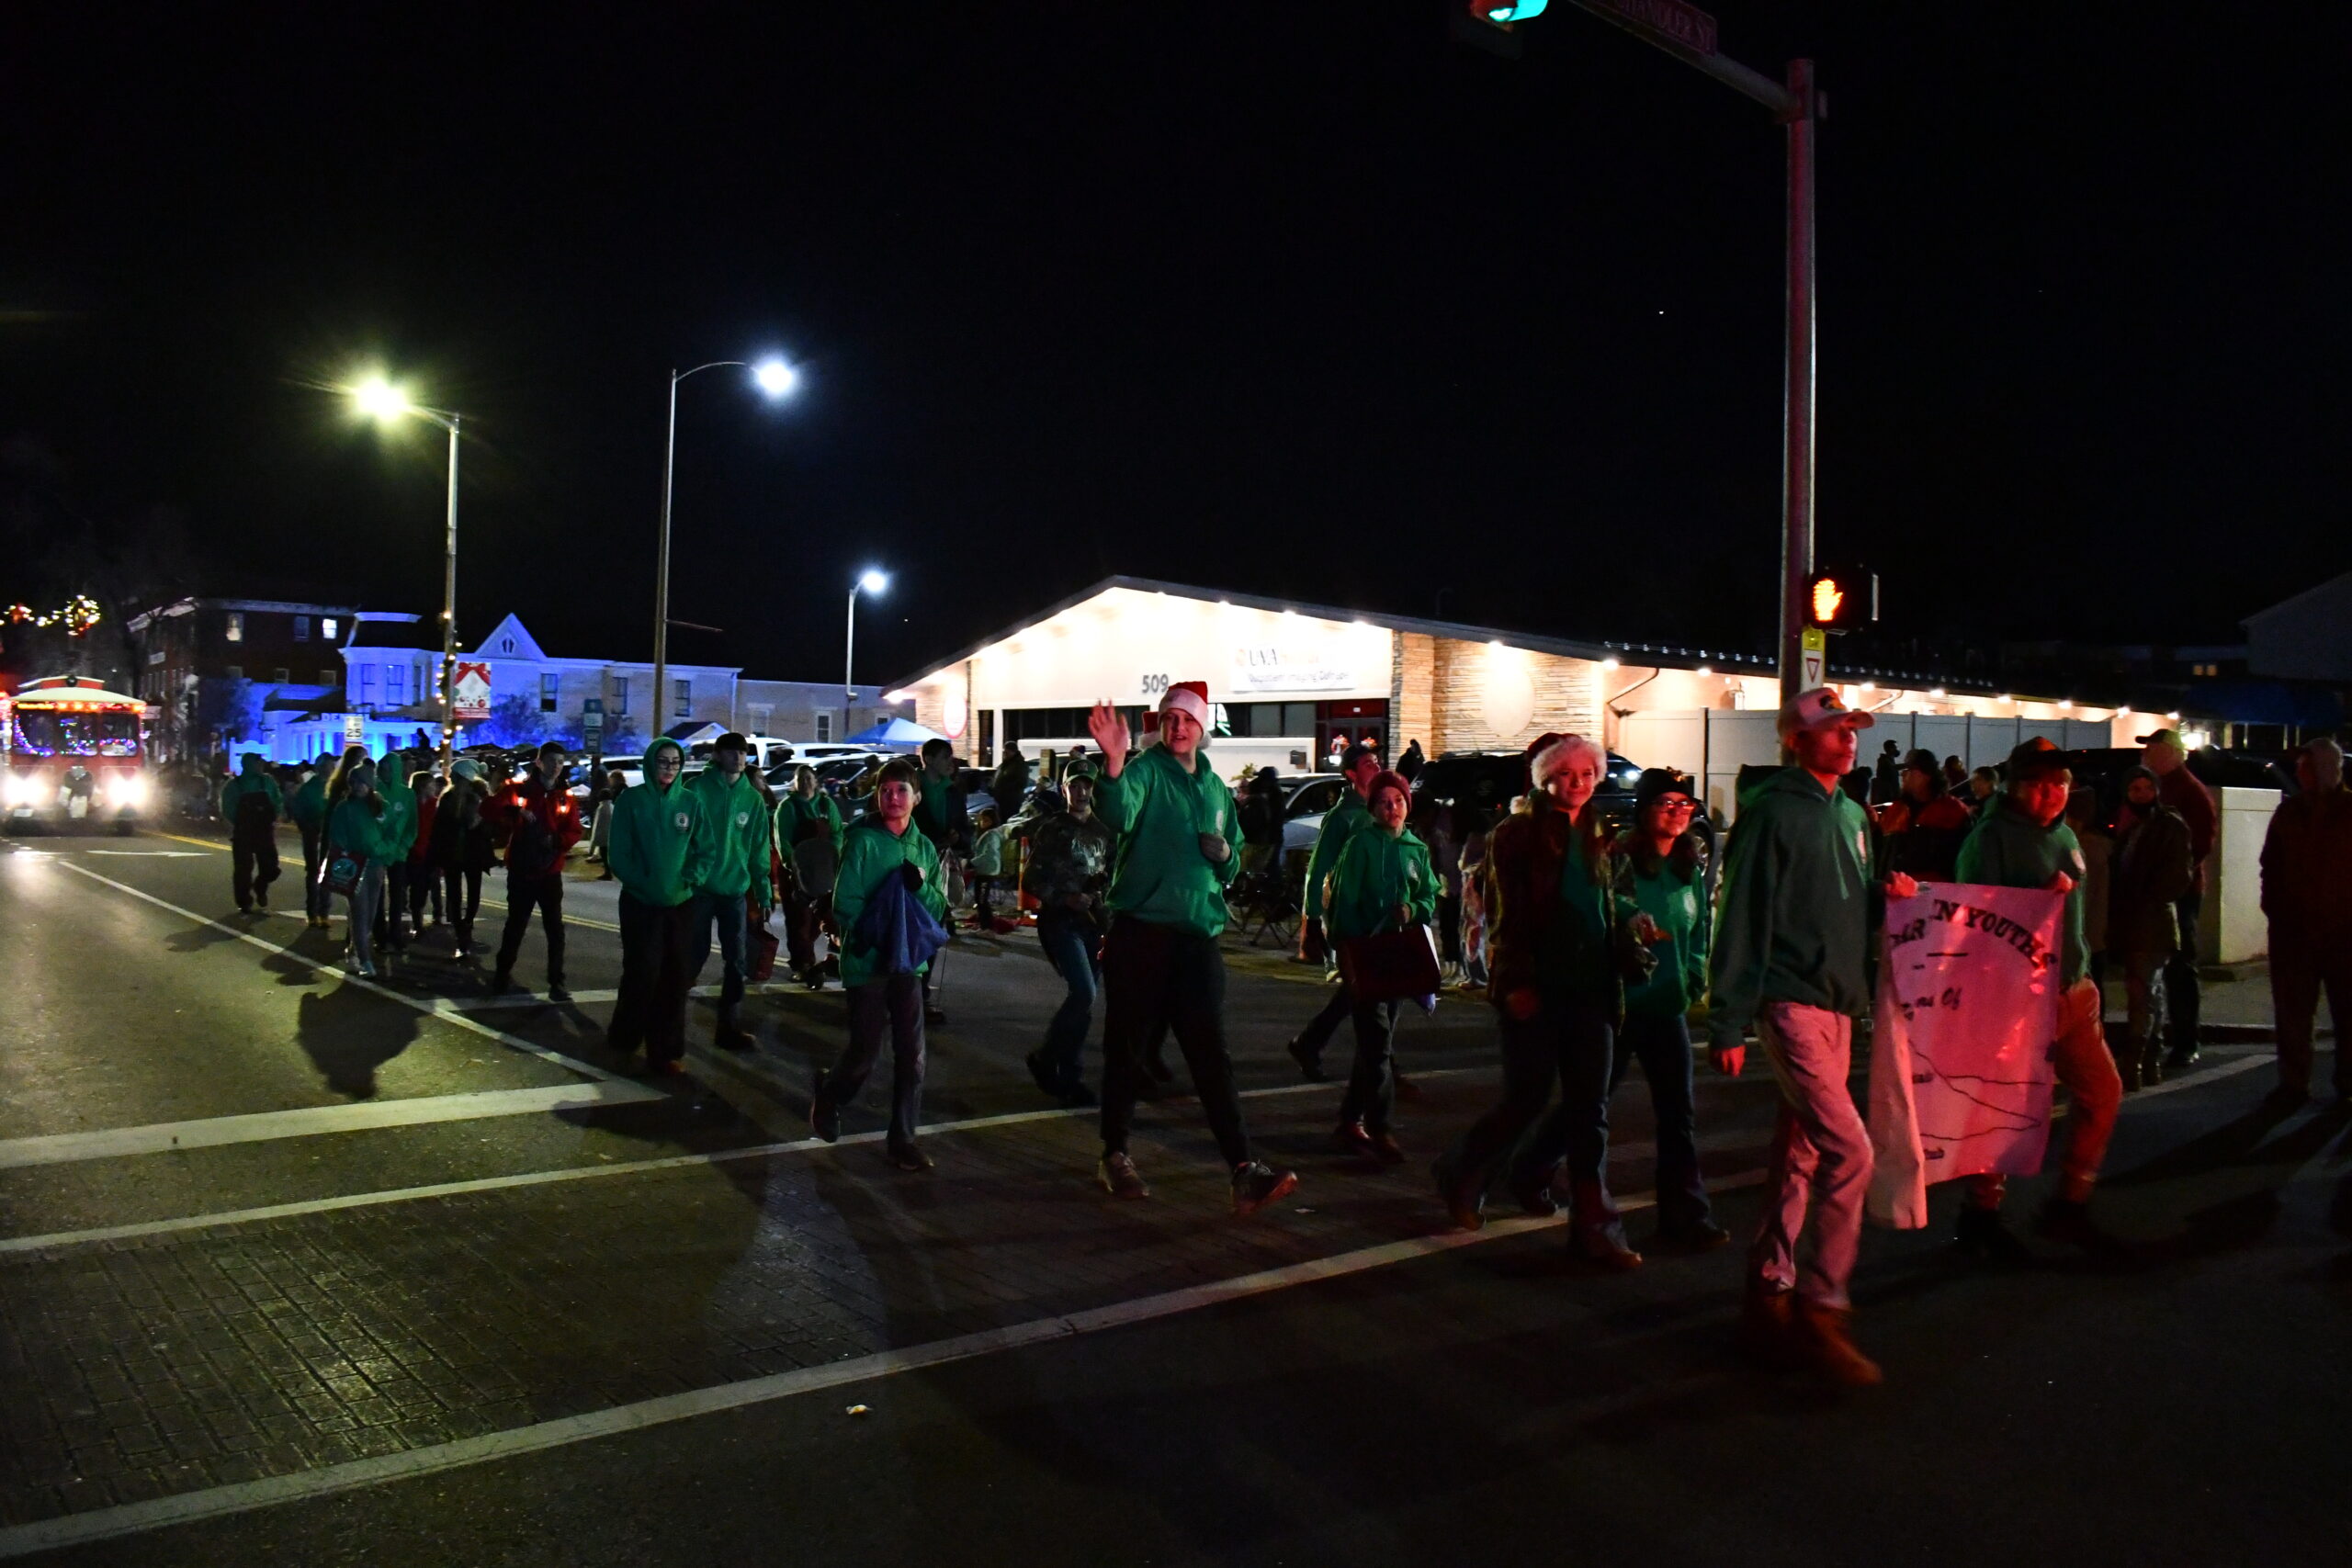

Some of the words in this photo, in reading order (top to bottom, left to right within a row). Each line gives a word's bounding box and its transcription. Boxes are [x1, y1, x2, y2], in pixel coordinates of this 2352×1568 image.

[1614, 0, 1691, 41] HANDLER
[1142, 673, 1169, 694] 509
[346, 728, 362, 738] 25
[1964, 906, 2058, 969] YOUTHS
